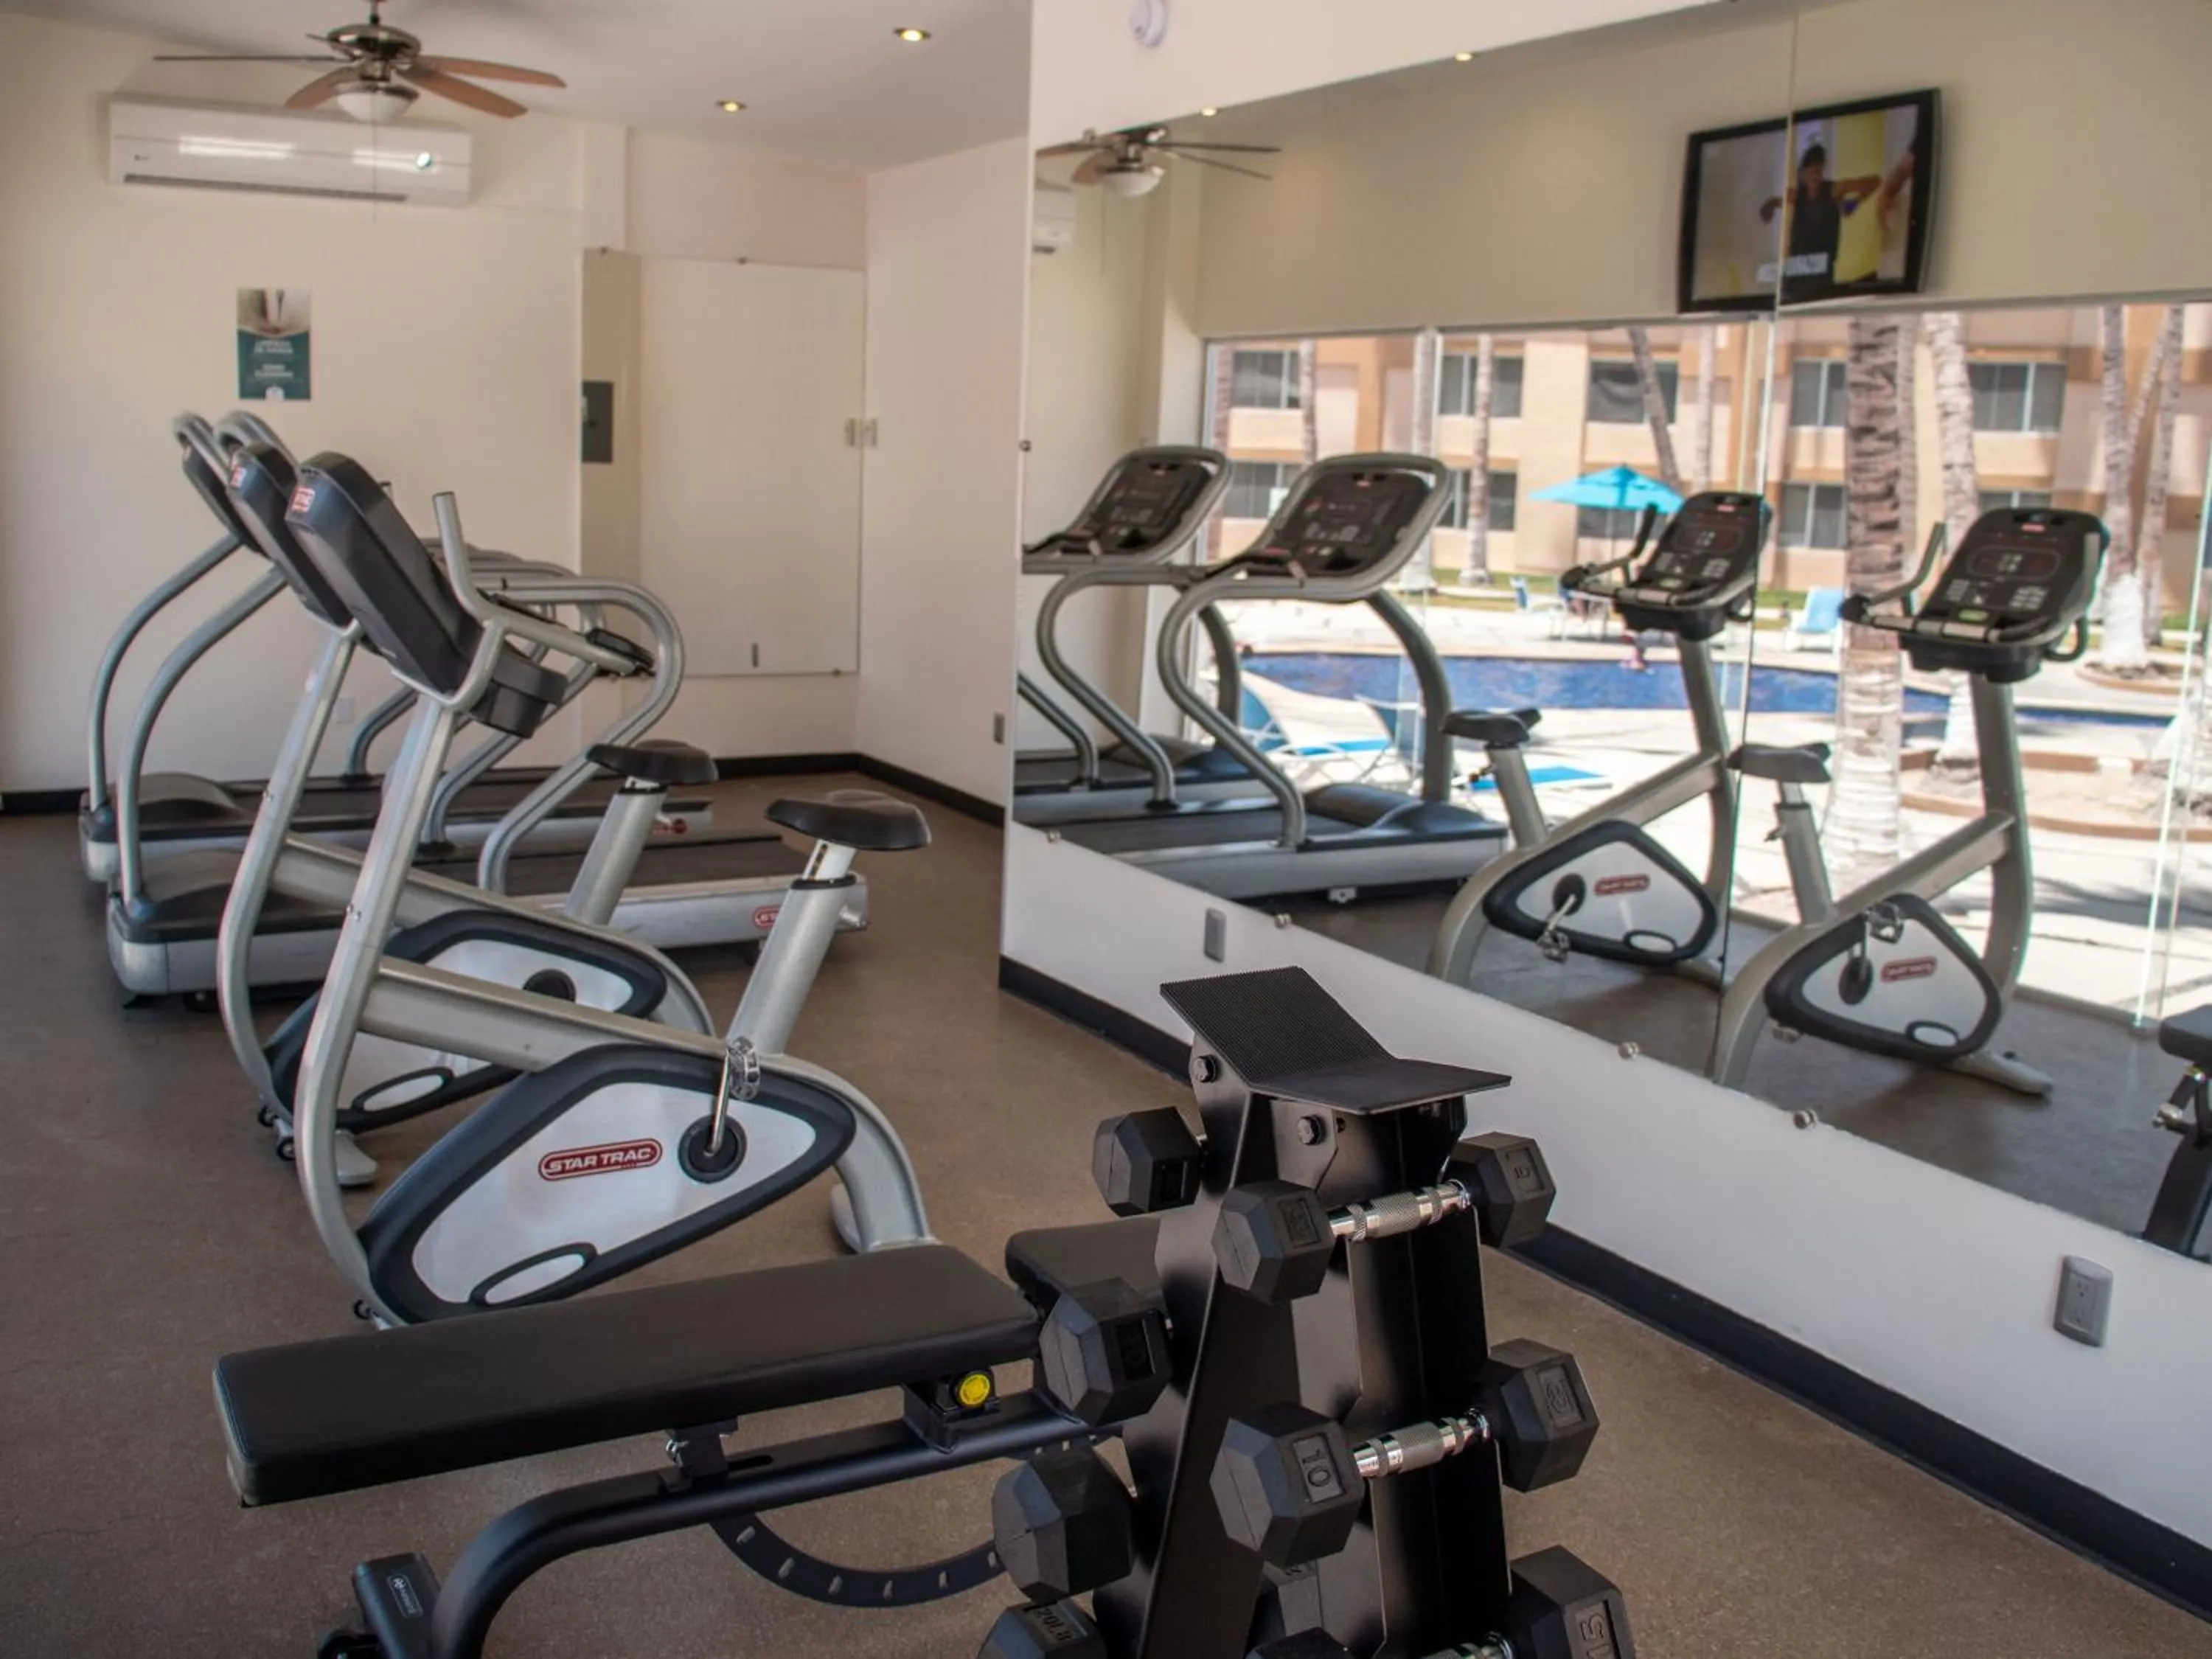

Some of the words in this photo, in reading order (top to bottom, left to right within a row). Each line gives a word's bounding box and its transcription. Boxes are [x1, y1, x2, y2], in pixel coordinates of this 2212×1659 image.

[546, 1155, 597, 1173] STAR
[599, 1147, 651, 1165] TRAC
[1301, 1447, 1332, 1488] 10
